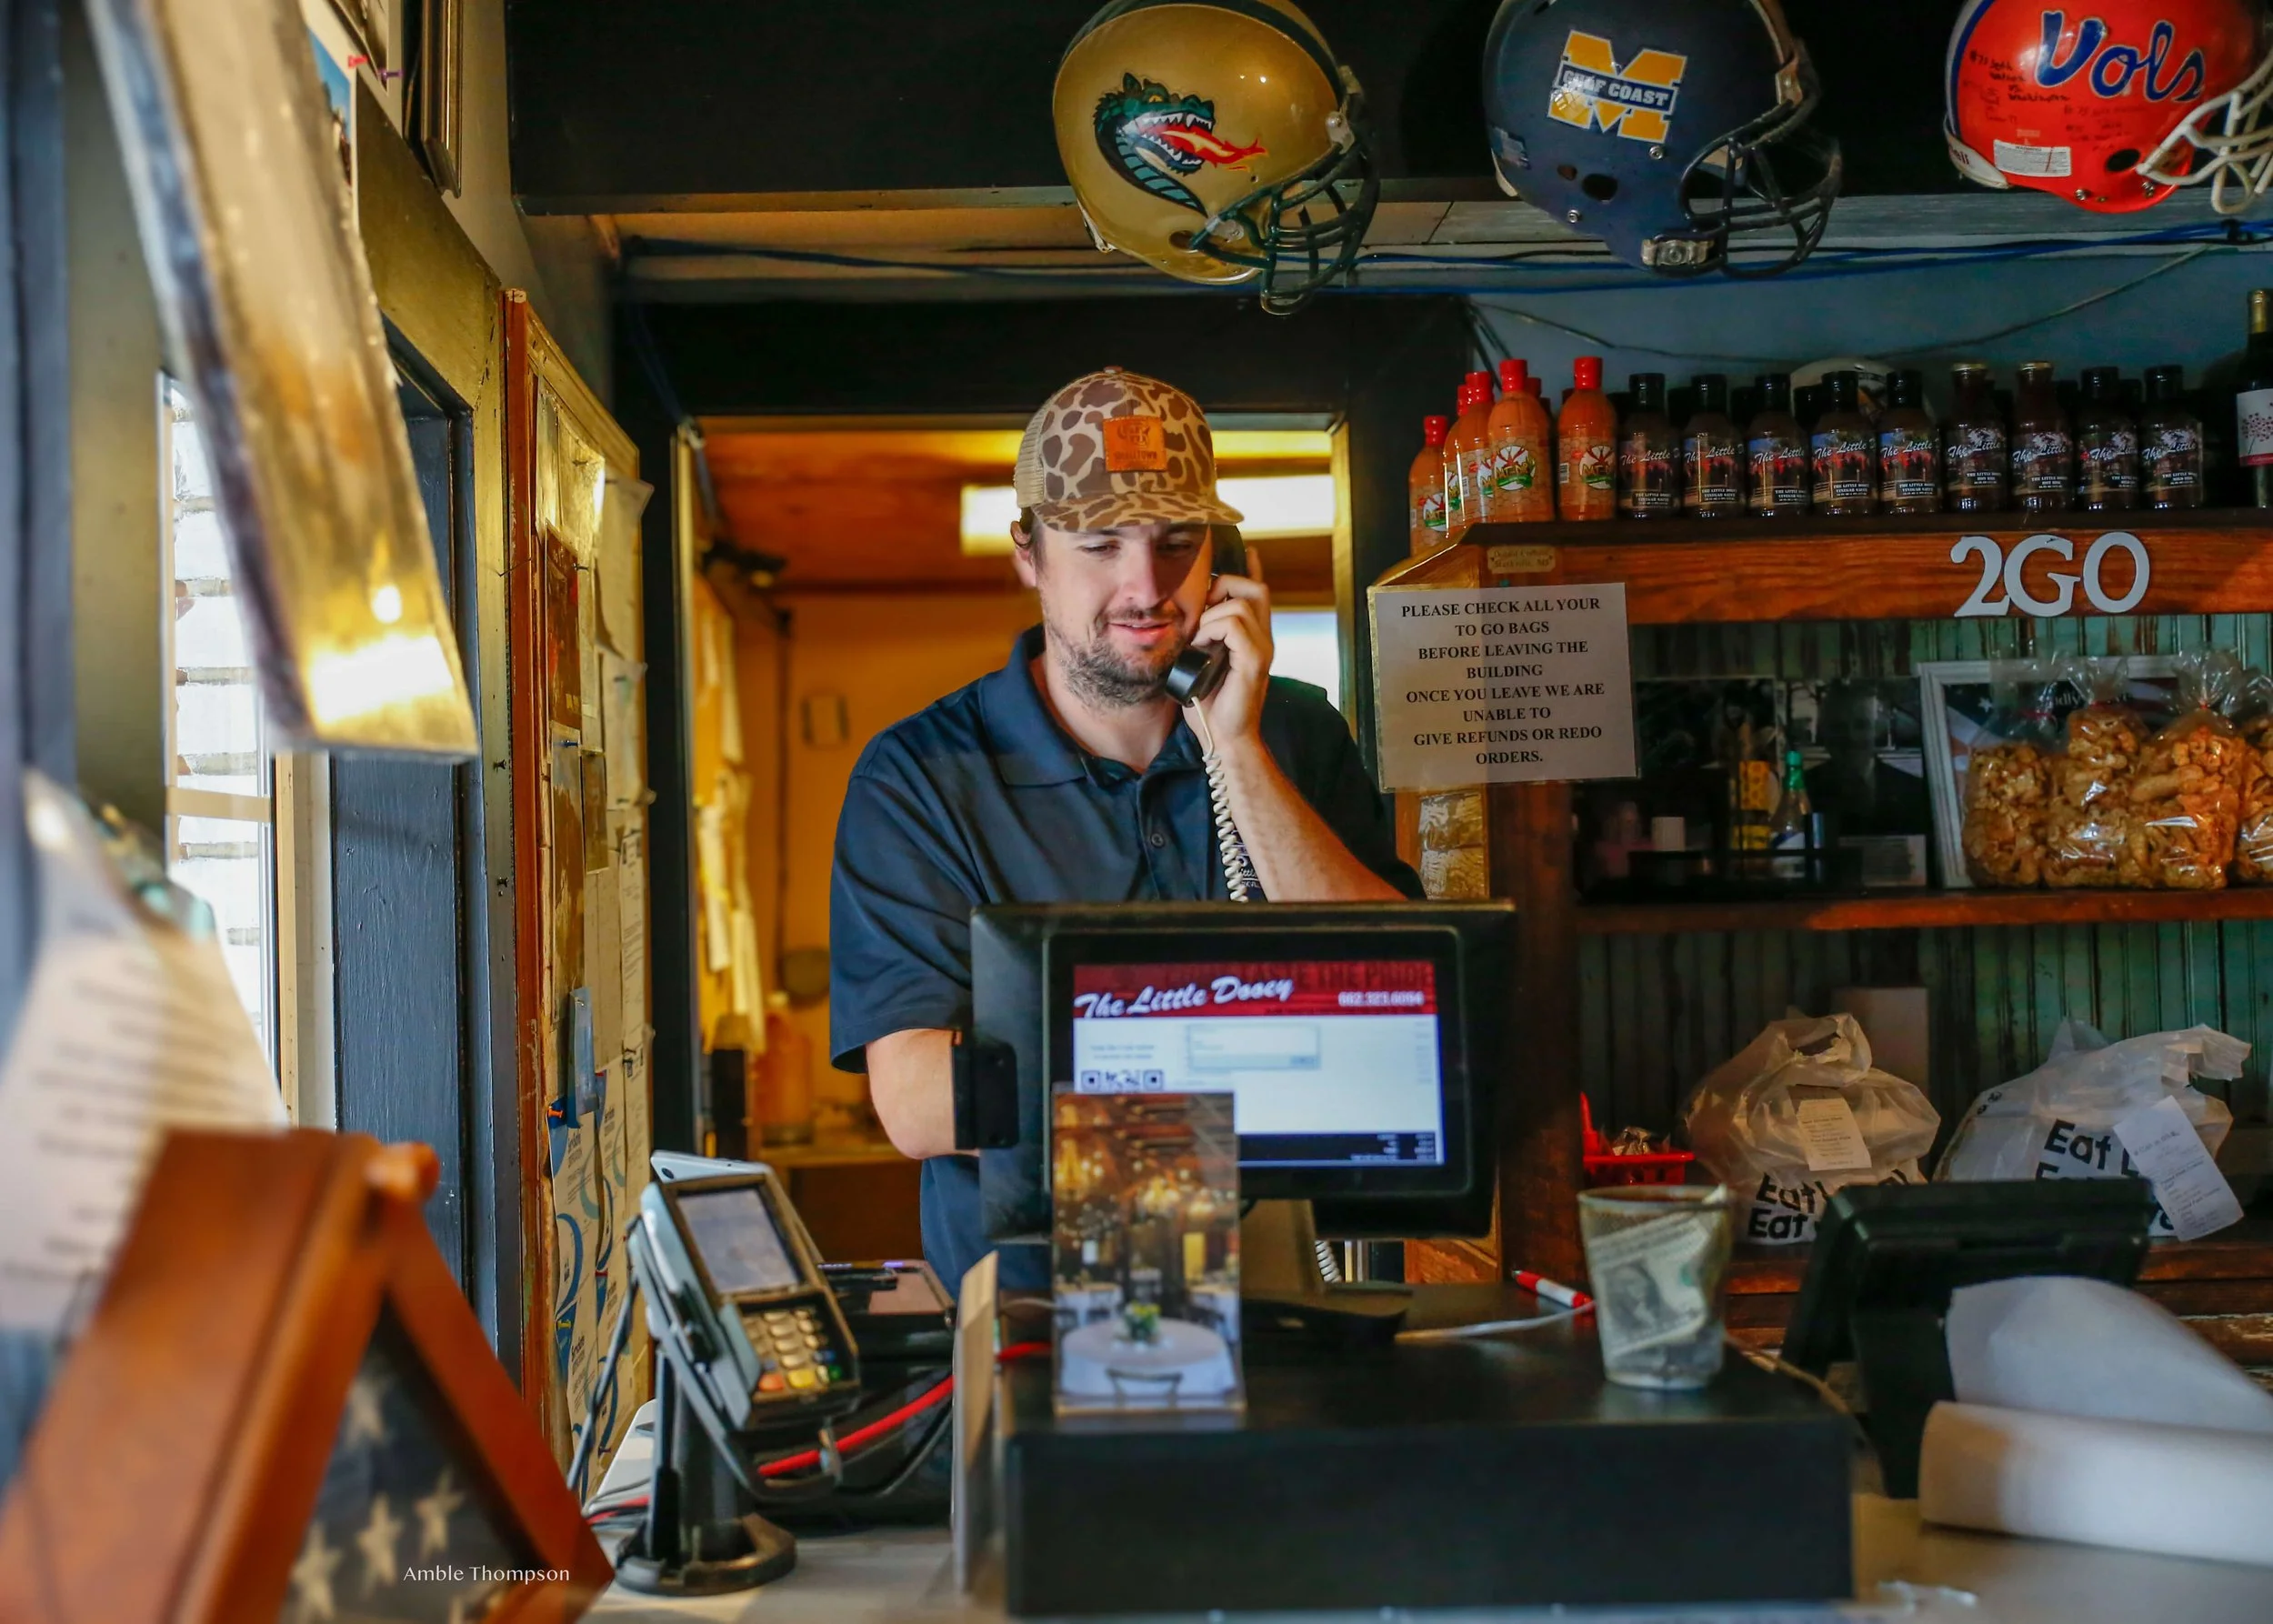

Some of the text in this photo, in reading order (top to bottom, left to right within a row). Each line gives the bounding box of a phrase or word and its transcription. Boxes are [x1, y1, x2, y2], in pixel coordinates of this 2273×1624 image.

[2034, 10, 2205, 103] Vols
[1607, 83, 1669, 106] COAST
[1621, 455, 1637, 466] The
[1640, 449, 1671, 462] Little
[1684, 453, 1700, 463] The
[1706, 446, 1735, 458] Little
[1815, 448, 1832, 459] The
[1837, 440, 1867, 454] Little
[1880, 440, 1932, 458] The Little
[1948, 440, 2000, 457] The Little
[2012, 444, 2067, 462] The Little
[2090, 448, 2112, 460] The
[2142, 441, 2196, 459] The Little
[1755, 452, 1774, 464] The
[1949, 531, 2150, 617] 2GO
[1401, 597, 1601, 617] PLEASE CHECK ALL YOUR
[1455, 621, 1549, 637] TO GO BAGS
[1418, 641, 1588, 659] BEFORE LEAVING THE
[1467, 665, 1543, 679] BUILDING
[1407, 683, 1605, 703] ONCE YOU LEAVE WE ARE
[1463, 707, 1551, 722] UNABLE TO
[1414, 726, 1602, 746] GIVE REFUNDS OR REDO
[1476, 750, 1543, 765] ORDERS.
[1074, 975, 1293, 1018] The Little Dooey
[2044, 1118, 2111, 1170] Eat
[1756, 1172, 1817, 1214] Eat
[1748, 1207, 1809, 1238] Eat
